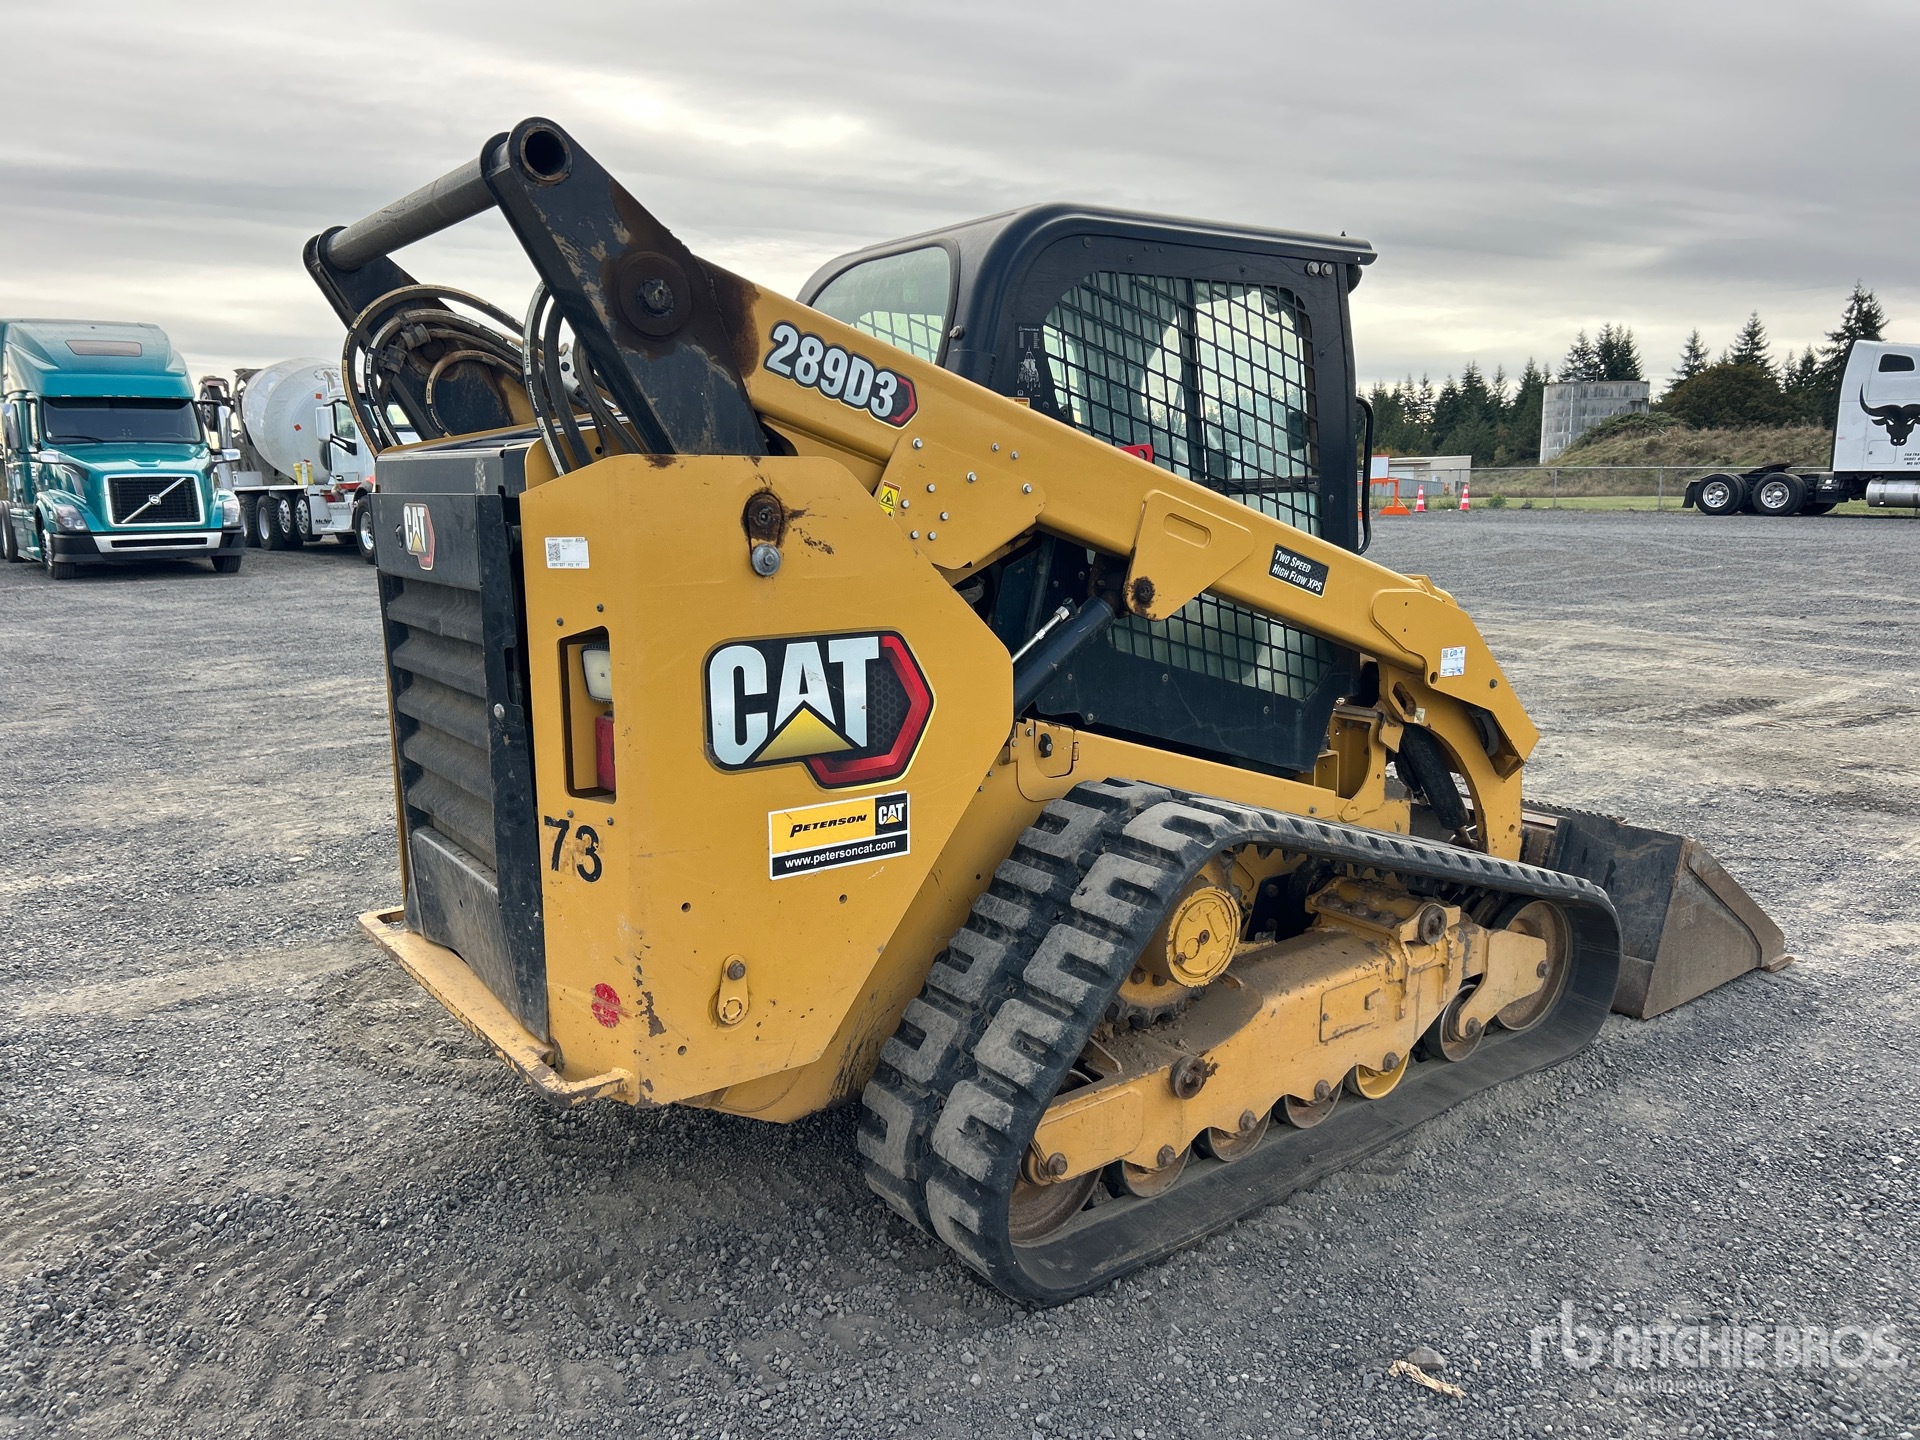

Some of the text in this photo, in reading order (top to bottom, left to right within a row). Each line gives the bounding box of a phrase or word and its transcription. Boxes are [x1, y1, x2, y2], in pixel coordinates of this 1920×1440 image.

[765, 323, 899, 419] 289D3
[403, 505, 427, 553] CAT
[1306, 577, 1323, 592] XPS
[709, 635, 880, 765] CAT
[878, 802, 905, 826] CAT
[543, 815, 603, 883] 73
[784, 839, 897, 869] www.petersoncat.com
